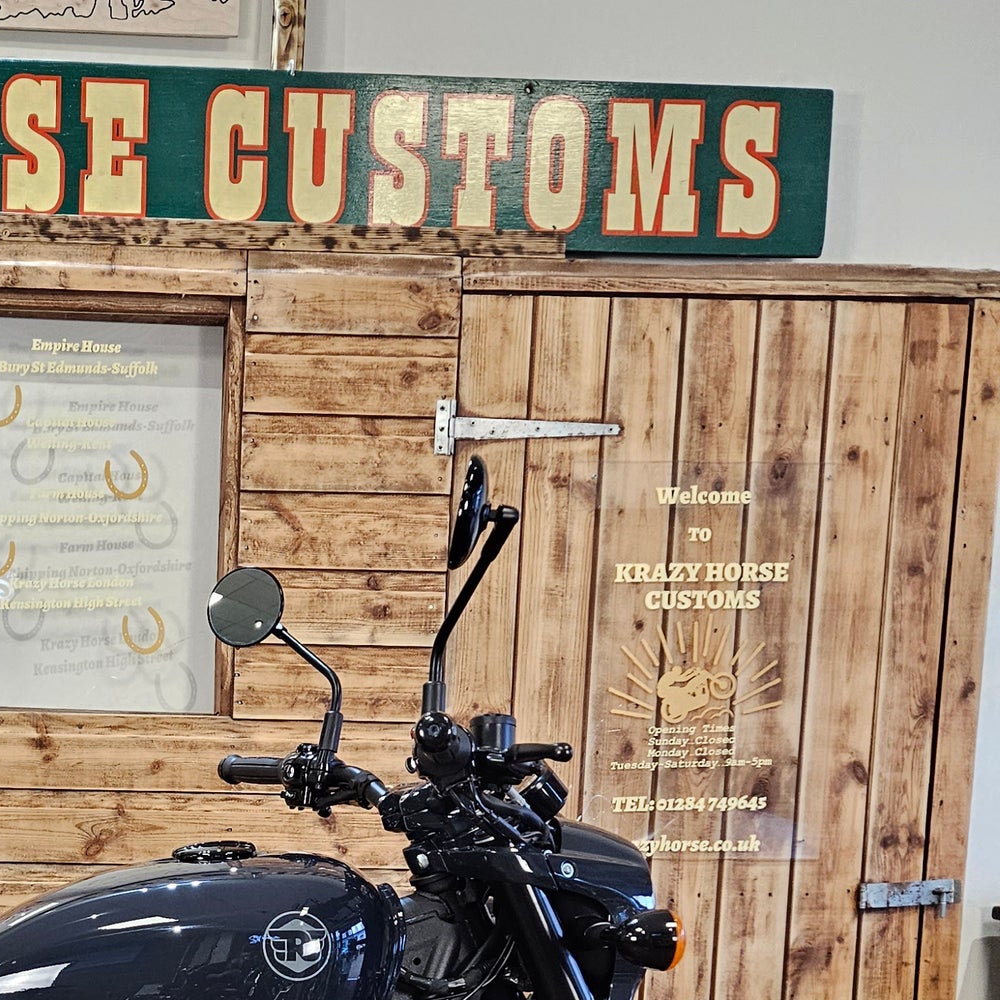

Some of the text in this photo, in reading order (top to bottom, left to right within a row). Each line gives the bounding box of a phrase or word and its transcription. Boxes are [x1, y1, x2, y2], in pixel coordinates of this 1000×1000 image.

[204, 84, 781, 240] CUSTOMS
[31, 338, 122, 354] Empire House
[31, 362, 46, 374] St
[46, 362, 158, 378] Edmunds-Suffolk
[656, 485, 752, 505] Welcome
[38, 512, 163, 525] Norton-Oxfordshire
[688, 527, 712, 542] TO
[614, 562, 790, 583] KRAZY HORSE
[0, 598, 72, 612] Kensington
[73, 597, 104, 611] High
[645, 589, 761, 610] CUSTOMS
[648, 724, 736, 737] Opening Times
[648, 736, 736, 747] Sunday Closed
[647, 747, 736, 758] Monday Closed
[707, 794, 768, 812] 749645
